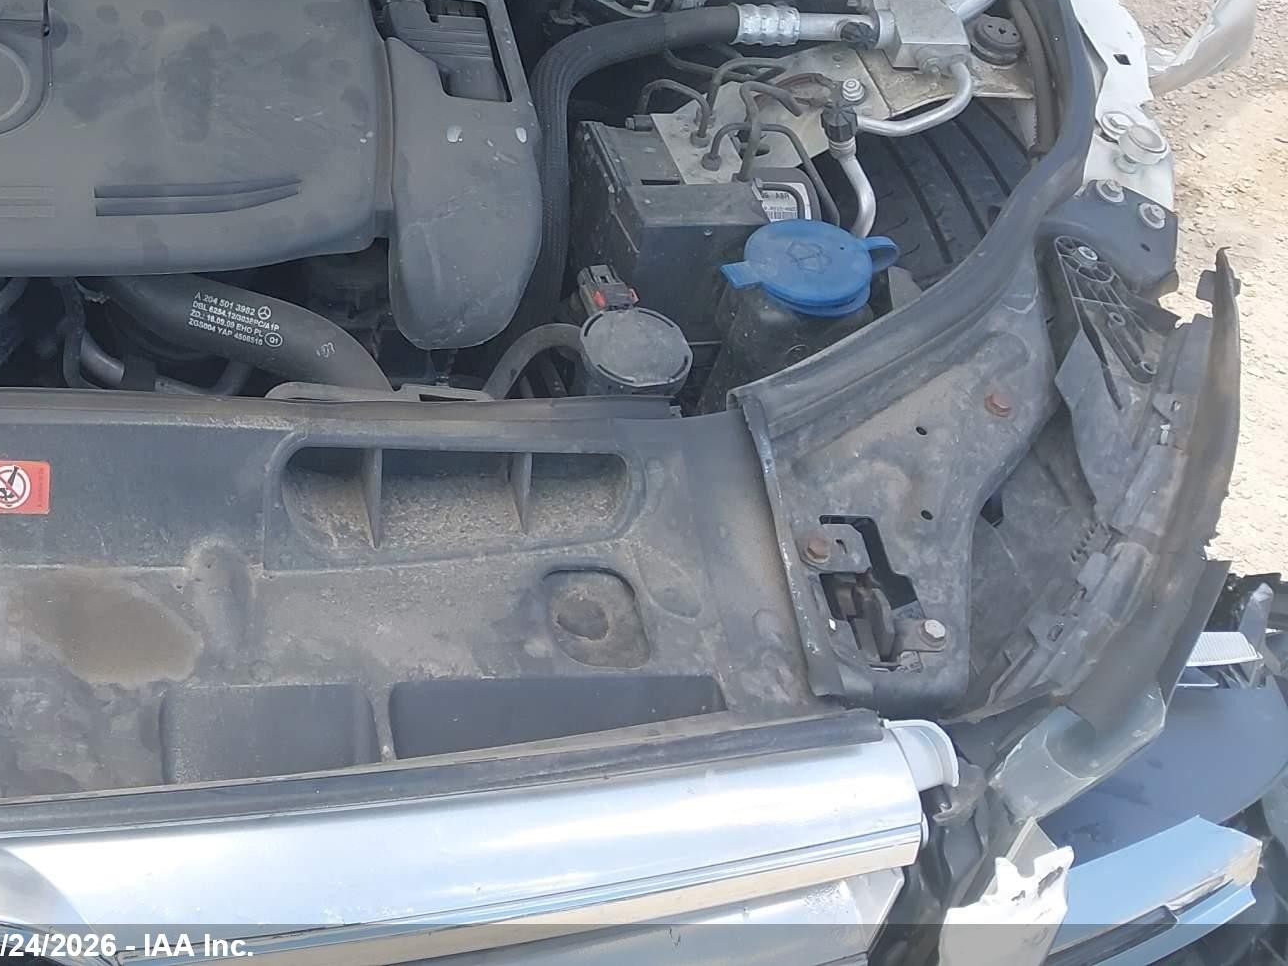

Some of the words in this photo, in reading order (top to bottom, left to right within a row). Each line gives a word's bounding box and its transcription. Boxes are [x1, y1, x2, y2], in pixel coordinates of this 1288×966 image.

[192, 300, 208, 312] DBL
[195, 292, 202, 301] A
[203, 294, 219, 305] 204
[219, 298, 234, 310] 501
[235, 303, 256, 316] 3982
[253, 328, 264, 337] PL
